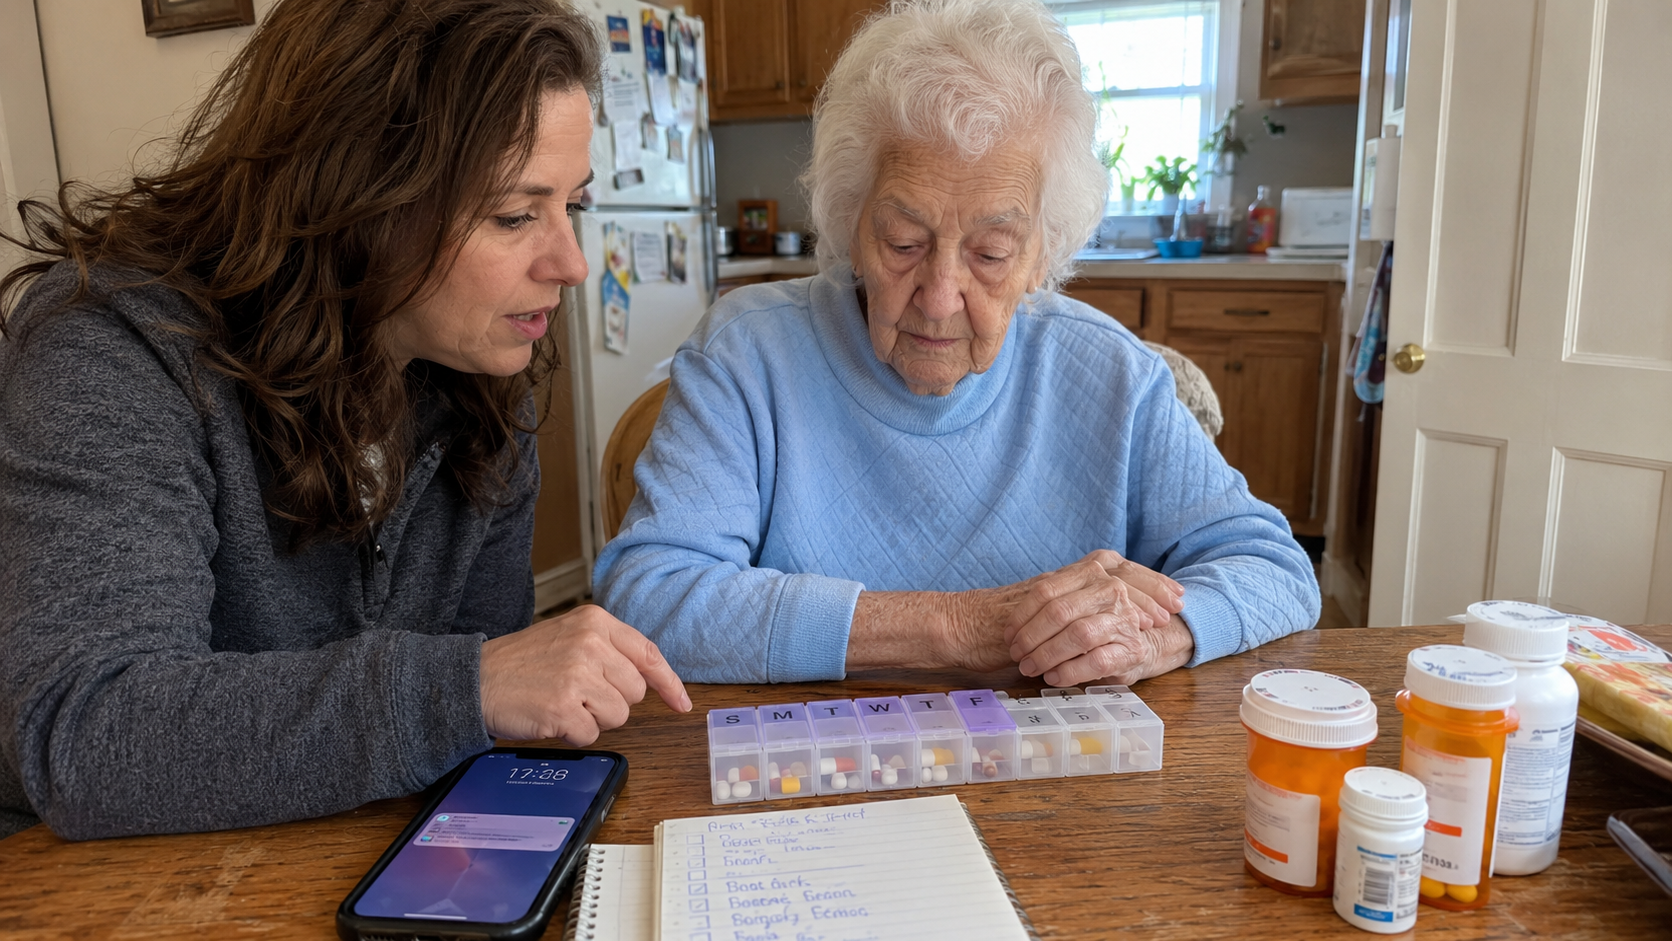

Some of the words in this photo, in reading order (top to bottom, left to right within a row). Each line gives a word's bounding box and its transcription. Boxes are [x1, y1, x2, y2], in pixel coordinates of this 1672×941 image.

[725, 714, 741, 724] S
[773, 709, 793, 720] M
[824, 706, 839, 716] T
[868, 703, 890, 713] W
[919, 700, 934, 709] T
[970, 697, 983, 706] F
